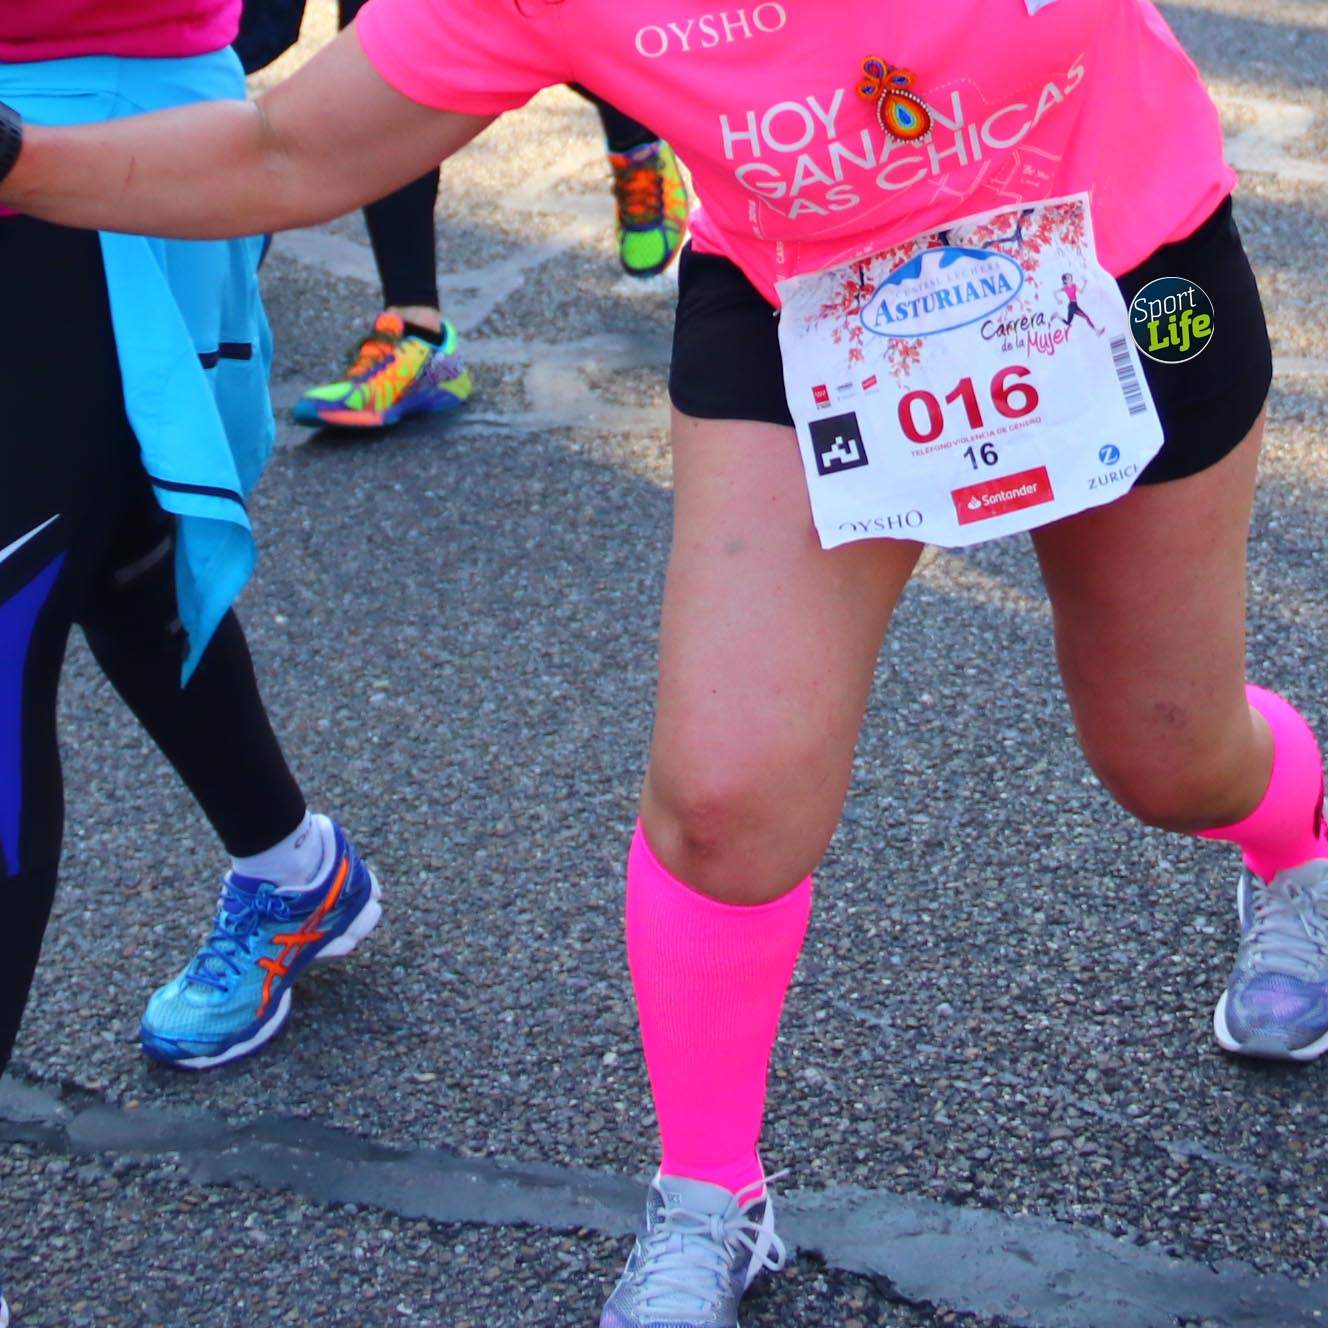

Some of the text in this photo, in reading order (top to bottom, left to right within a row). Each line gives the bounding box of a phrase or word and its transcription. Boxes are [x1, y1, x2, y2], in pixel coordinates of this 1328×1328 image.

[634, 1, 787, 59] OYSHO
[719, 88, 845, 161] HOY
[875, 54, 1086, 191] CHICAS
[873, 272, 1013, 327] ASTURIANA
[1134, 286, 1197, 324] Sport
[980, 310, 1046, 341] Carrera
[1001, 321, 1073, 358] de la Mujer
[1147, 309, 1212, 352] Life
[896, 364, 1040, 445] 016
[995, 425, 1008, 435] DE
[963, 441, 1000, 471] 16
[981, 481, 1039, 509] Santander
